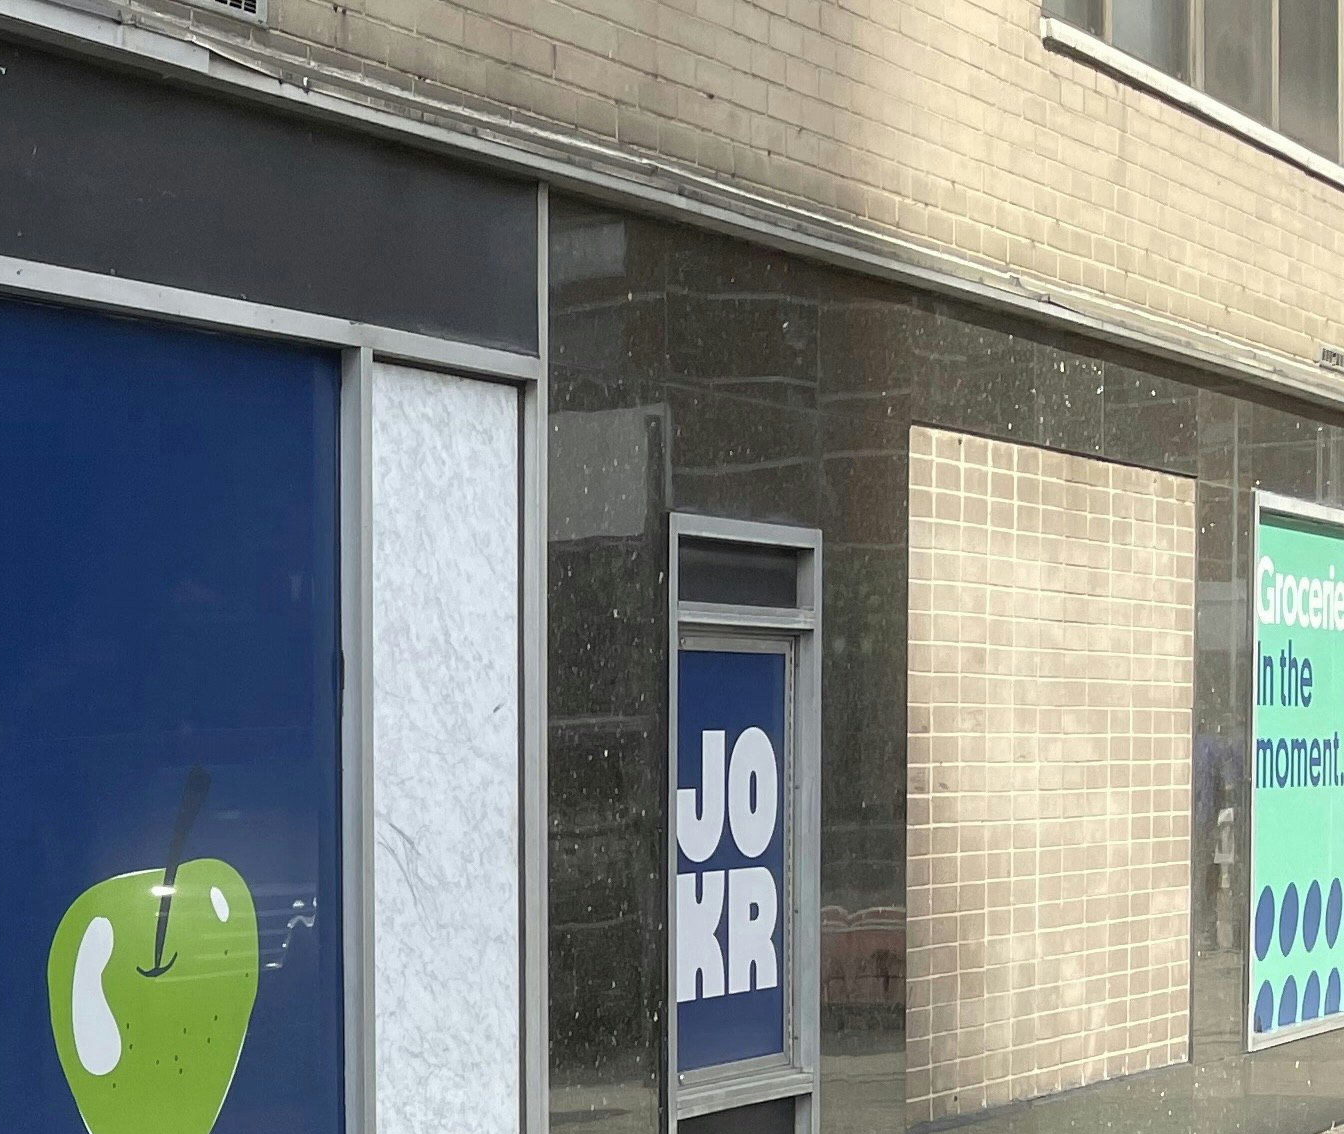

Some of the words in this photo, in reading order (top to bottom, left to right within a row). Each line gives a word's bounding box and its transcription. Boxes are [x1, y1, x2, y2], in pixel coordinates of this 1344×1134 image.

[1257, 640, 1274, 706] In
[1280, 639, 1313, 708] the
[677, 726, 778, 863] JO
[1256, 731, 1344, 789] moment.
[677, 866, 778, 1003] KR
